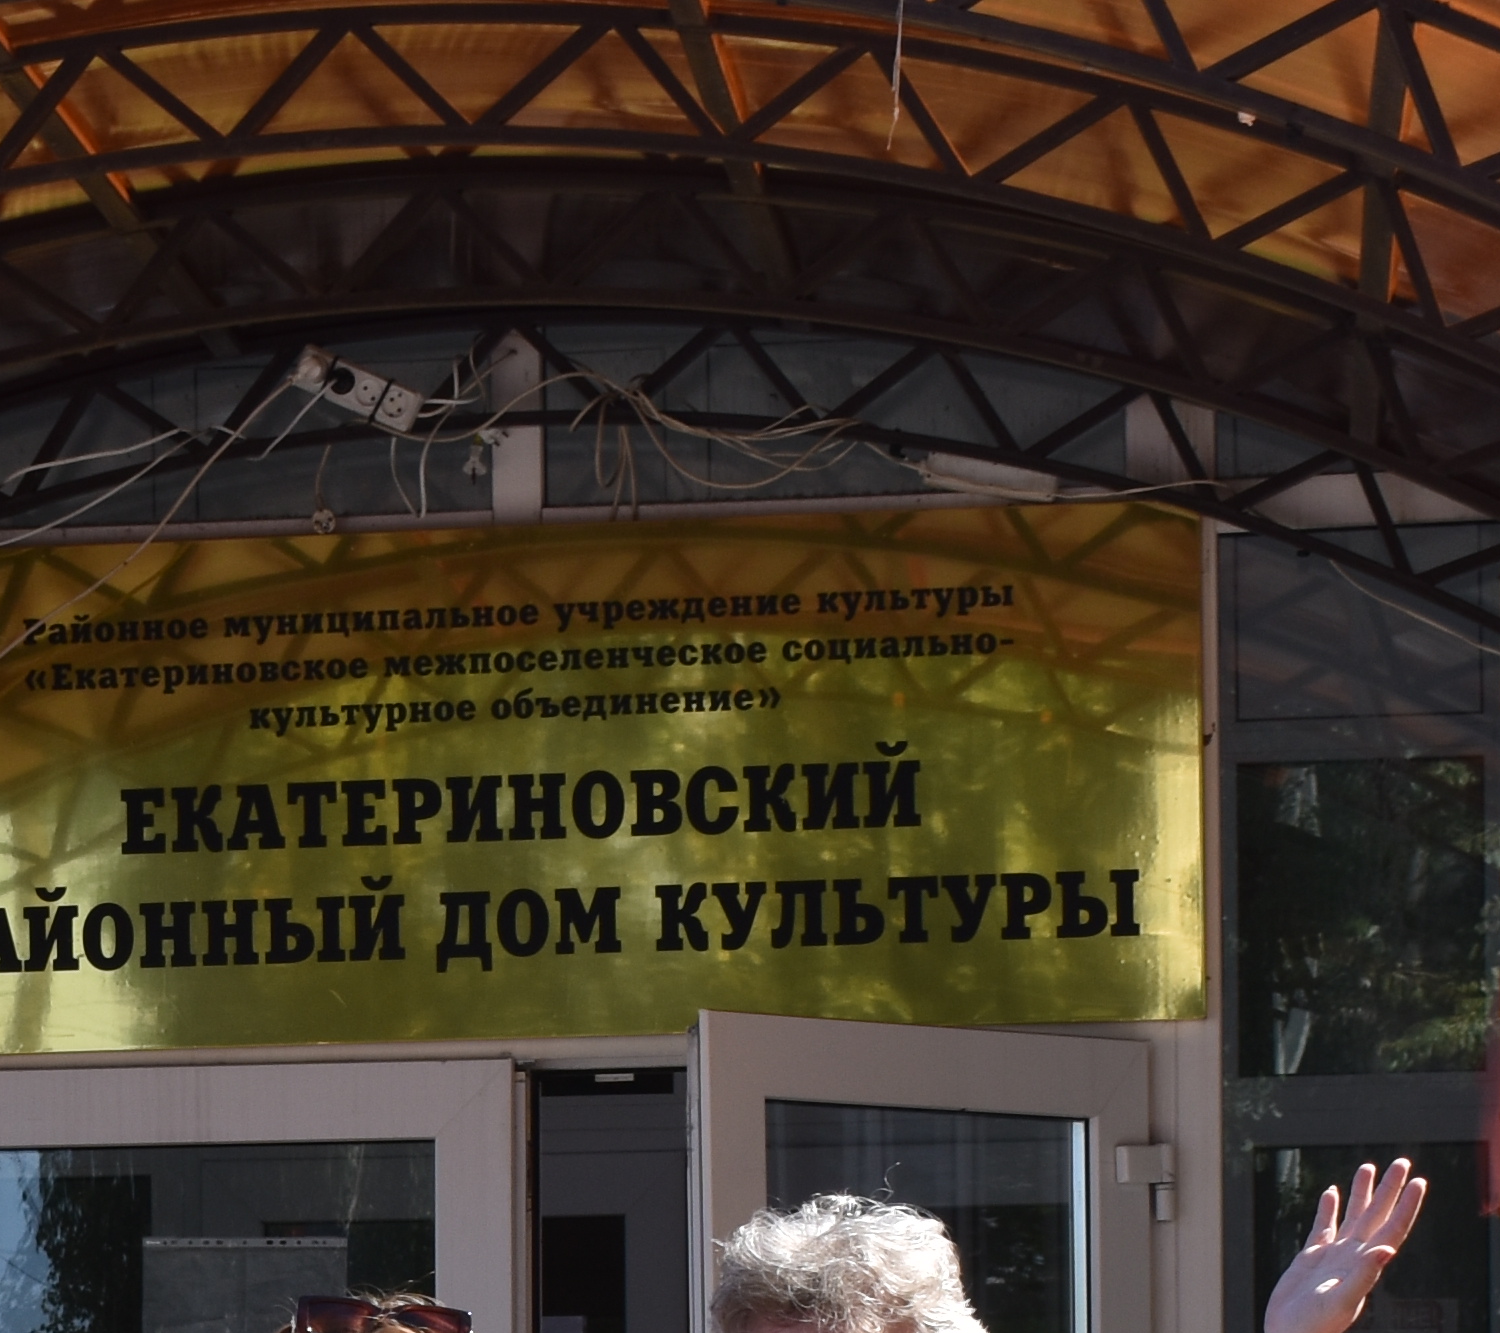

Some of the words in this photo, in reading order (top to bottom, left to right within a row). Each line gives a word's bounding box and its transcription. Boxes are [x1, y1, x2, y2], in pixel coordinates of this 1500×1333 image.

[23, 615, 208, 646] Районное
[224, 604, 538, 644] муниципальное
[554, 592, 801, 632] учреждение
[817, 584, 1014, 617] культуры
[25, 654, 369, 694] «Екатериновское
[384, 641, 767, 677] межпоселенческое
[782, 631, 1015, 664] социально-
[250, 697, 476, 736] культурное
[491, 686, 781, 722] объединение»
[121, 741, 921, 854] ЕКАТЕРИНОВСКИЙ
[436, 886, 621, 972] ДОМ
[655, 869, 1141, 952] КУЛЬТУРЫ
